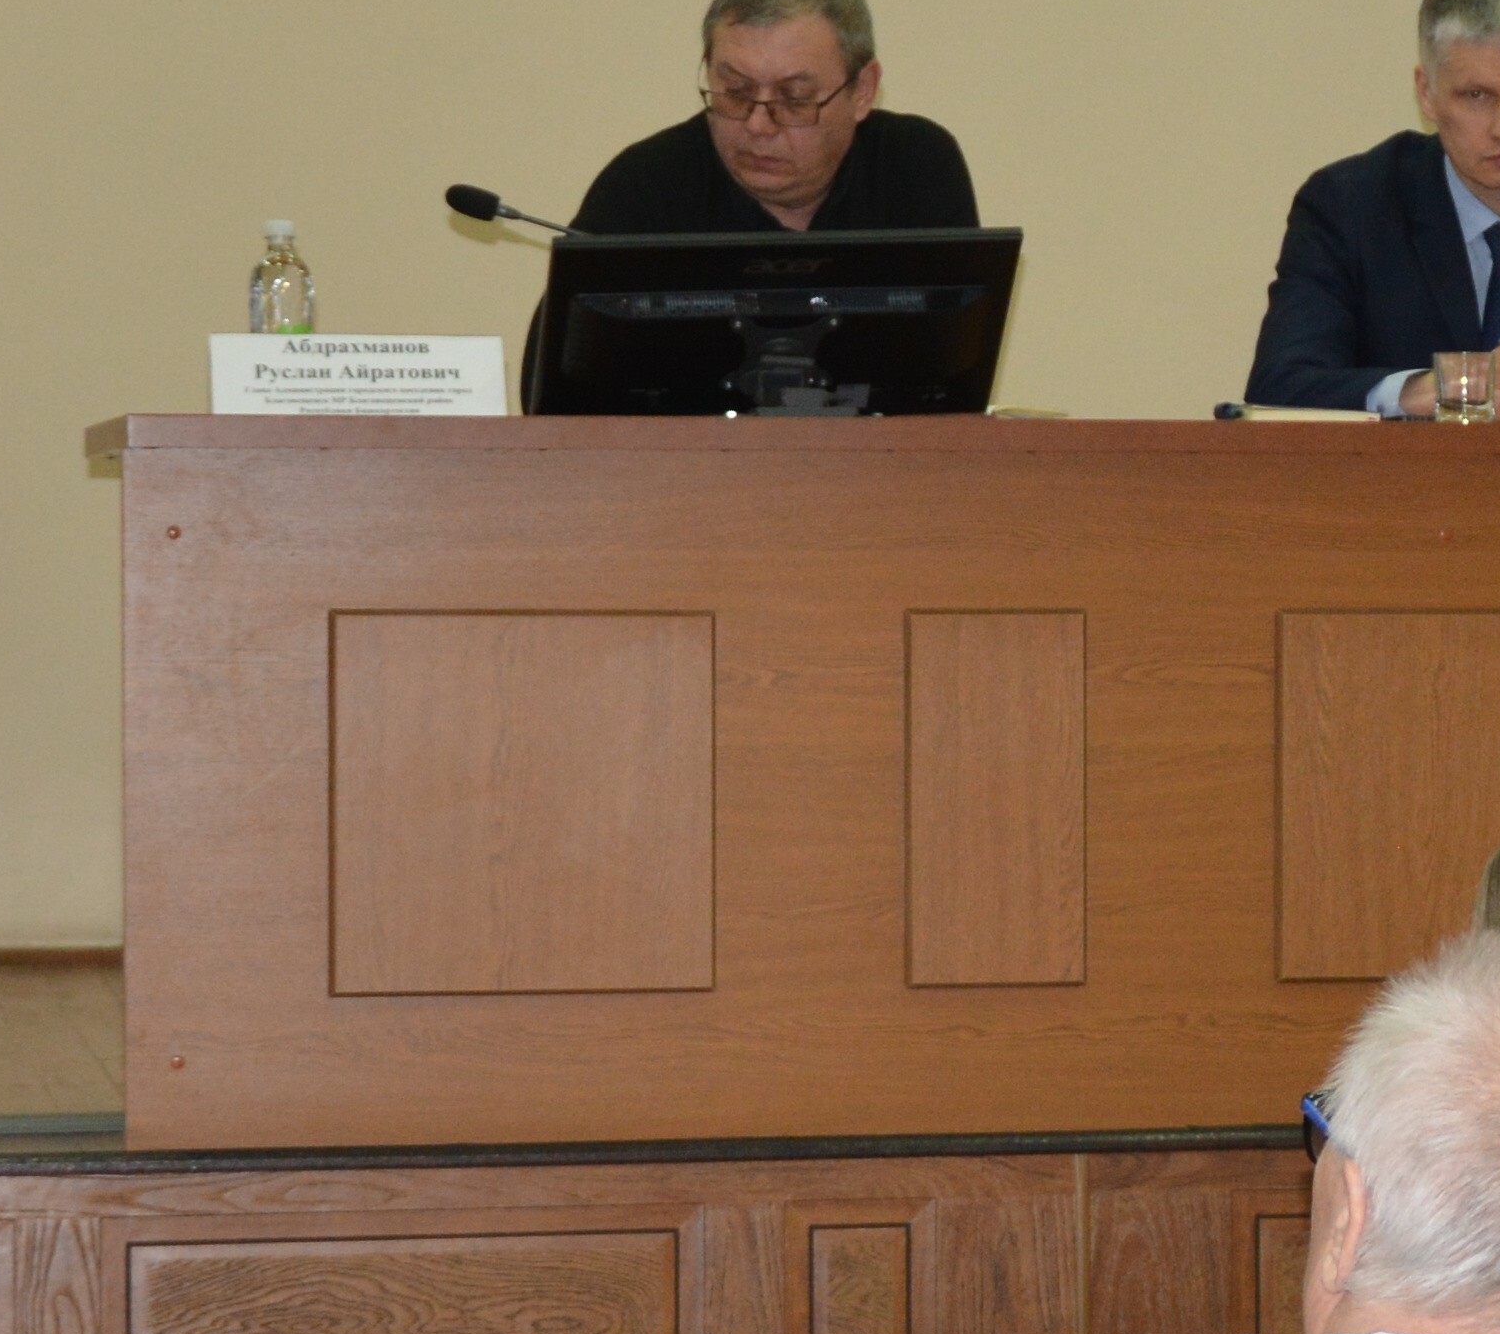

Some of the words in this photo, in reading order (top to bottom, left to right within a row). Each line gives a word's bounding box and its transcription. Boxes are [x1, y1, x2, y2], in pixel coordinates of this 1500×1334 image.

[282, 338, 431, 357] Абдрахманов
[254, 363, 332, 384] Руслан
[338, 361, 461, 384] Айратович
